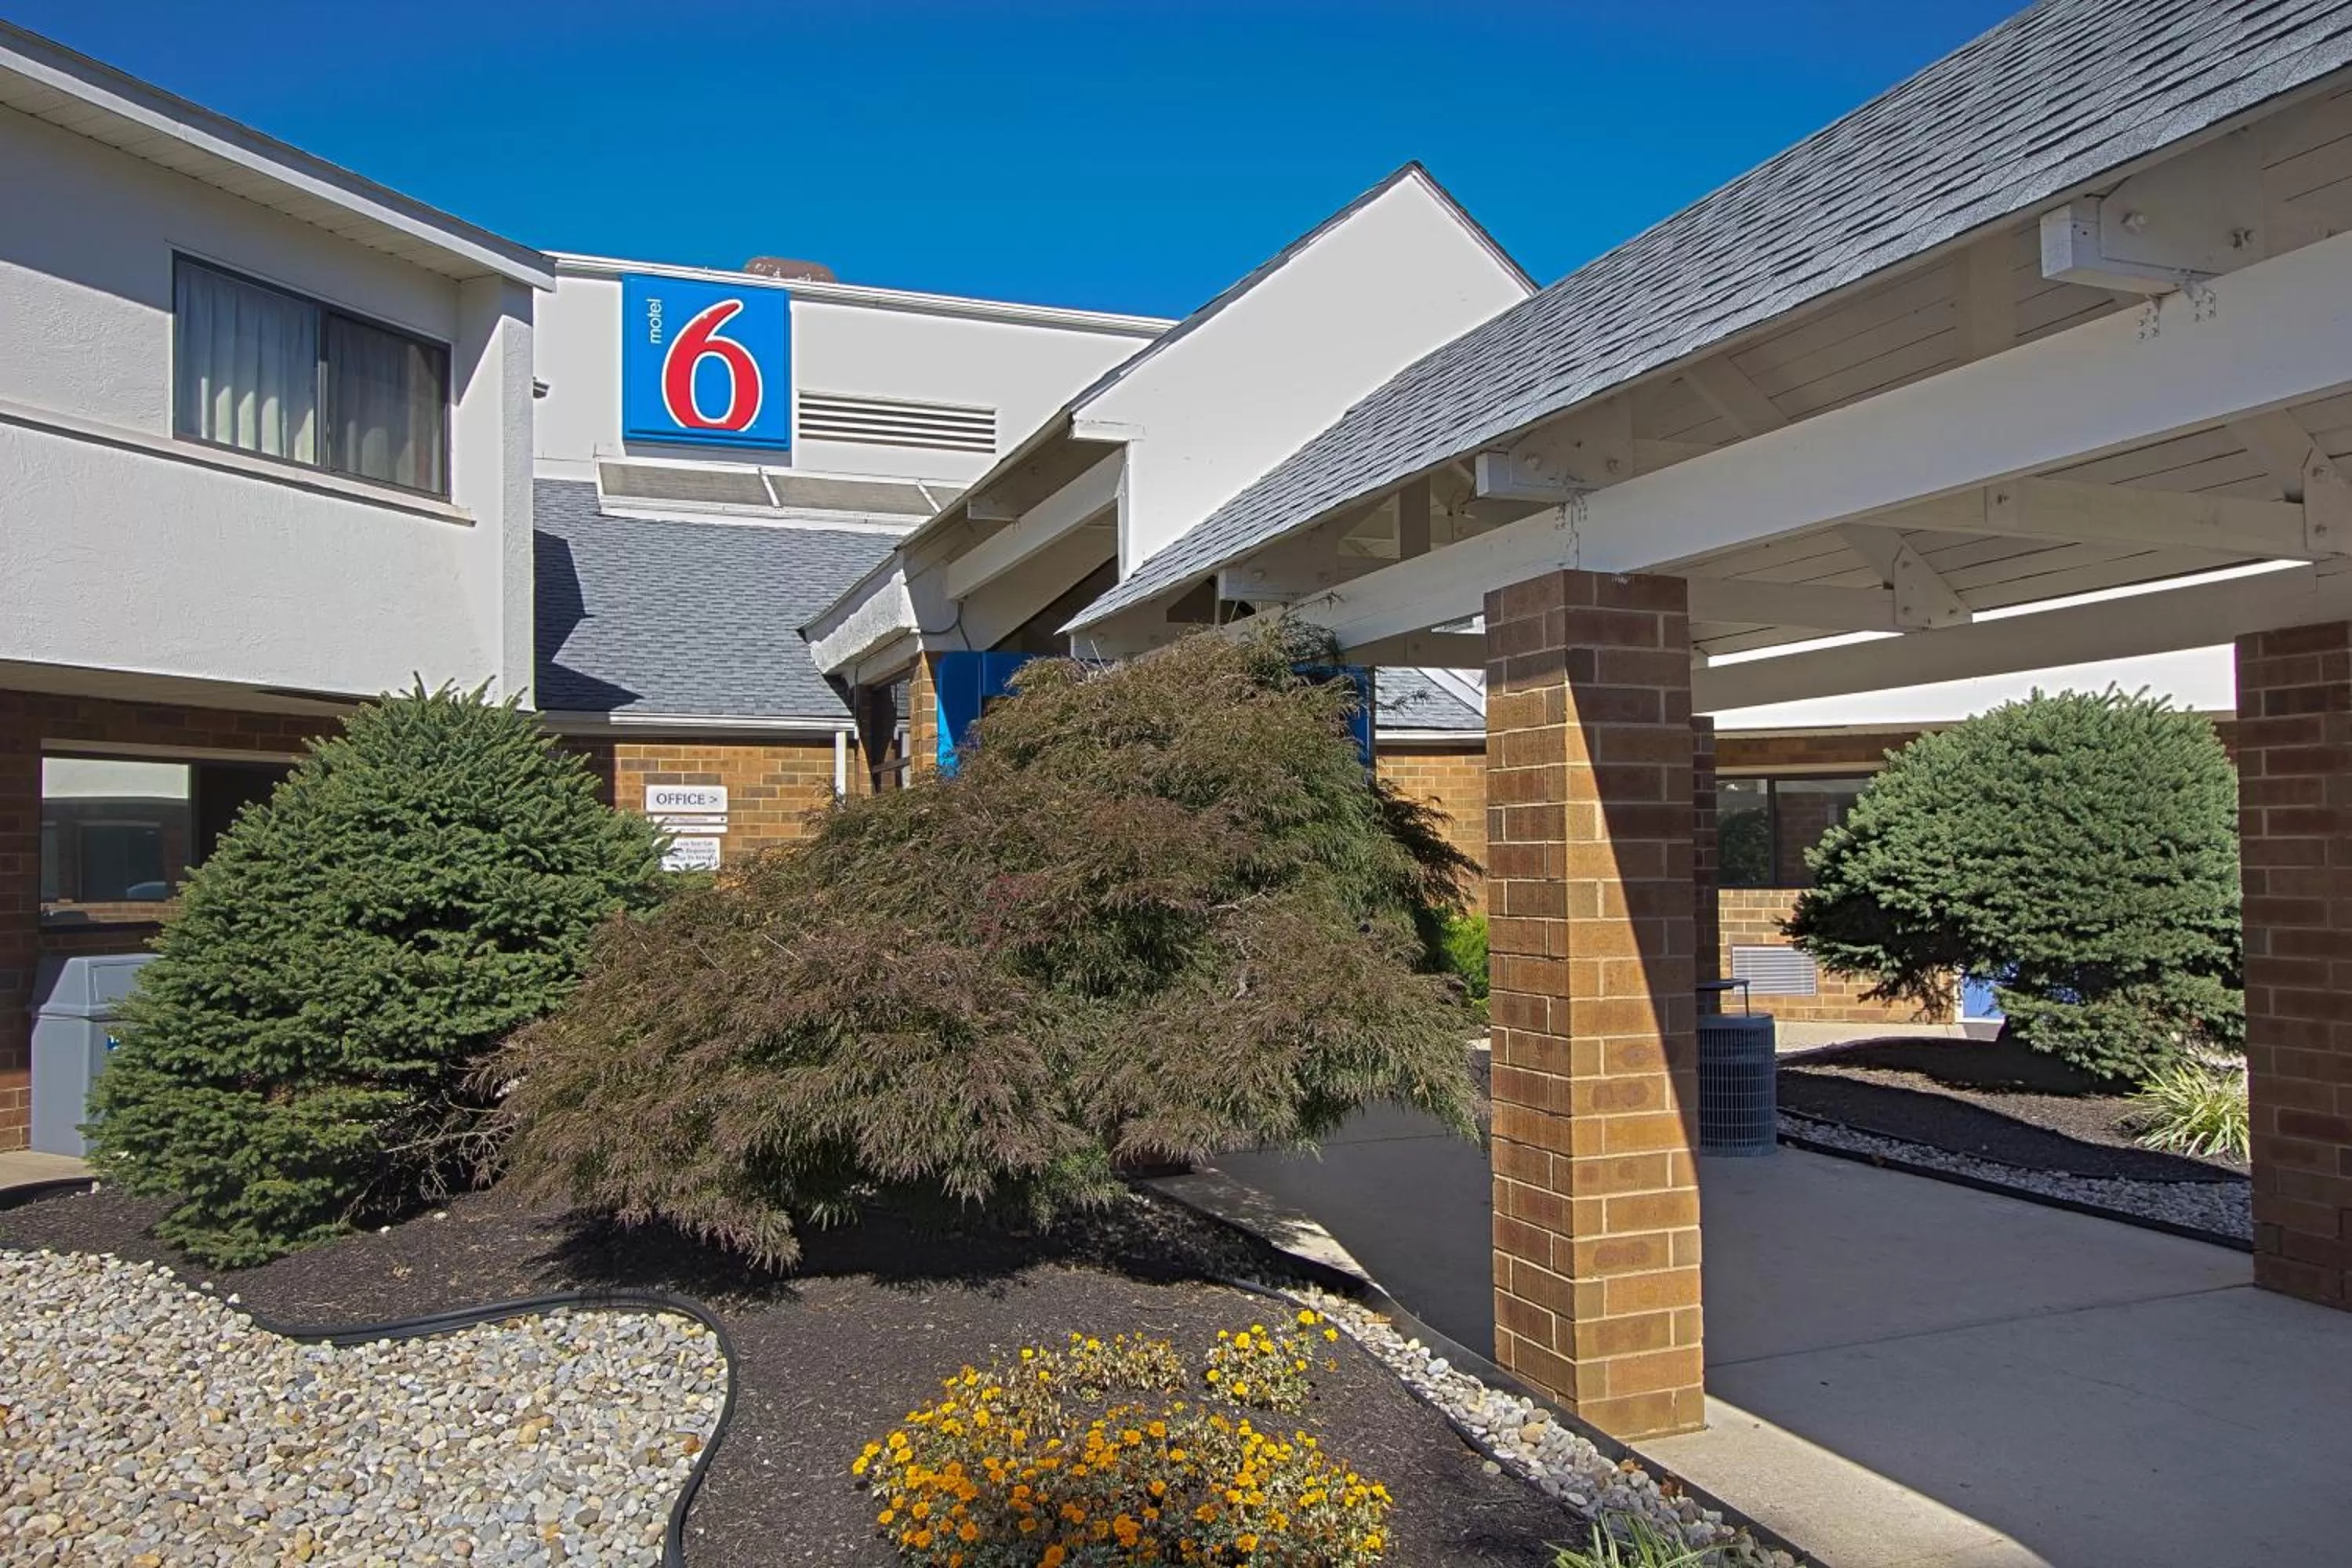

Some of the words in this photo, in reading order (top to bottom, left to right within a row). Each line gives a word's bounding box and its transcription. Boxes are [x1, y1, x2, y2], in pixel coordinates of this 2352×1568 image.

[646, 299, 662, 344] motel
[661, 299, 763, 431] 6
[656, 793, 706, 806] OFFICE
